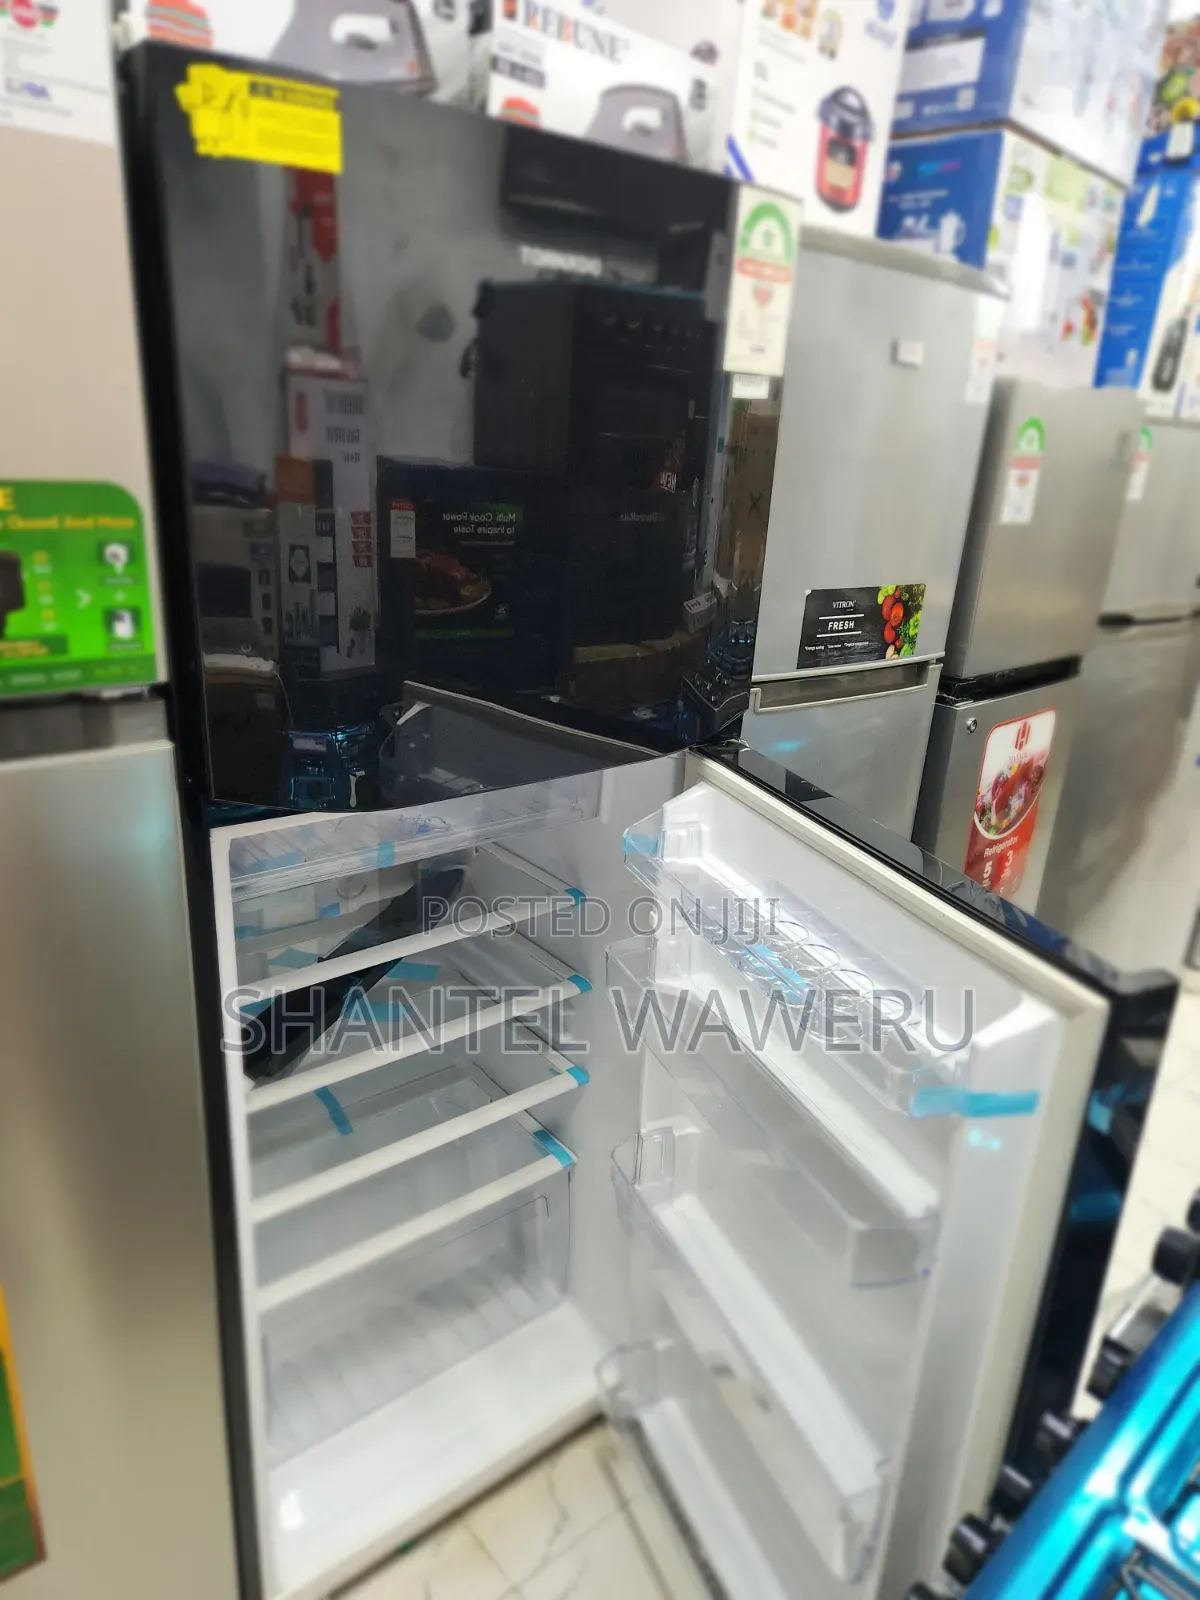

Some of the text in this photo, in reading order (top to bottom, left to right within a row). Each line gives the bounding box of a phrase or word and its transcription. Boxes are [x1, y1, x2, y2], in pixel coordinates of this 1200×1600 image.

[832, 600, 855, 609] VITRON
[828, 620, 855, 631] FRESH
[984, 836, 1019, 859] Refrigerator
[983, 860, 993, 879] 5
